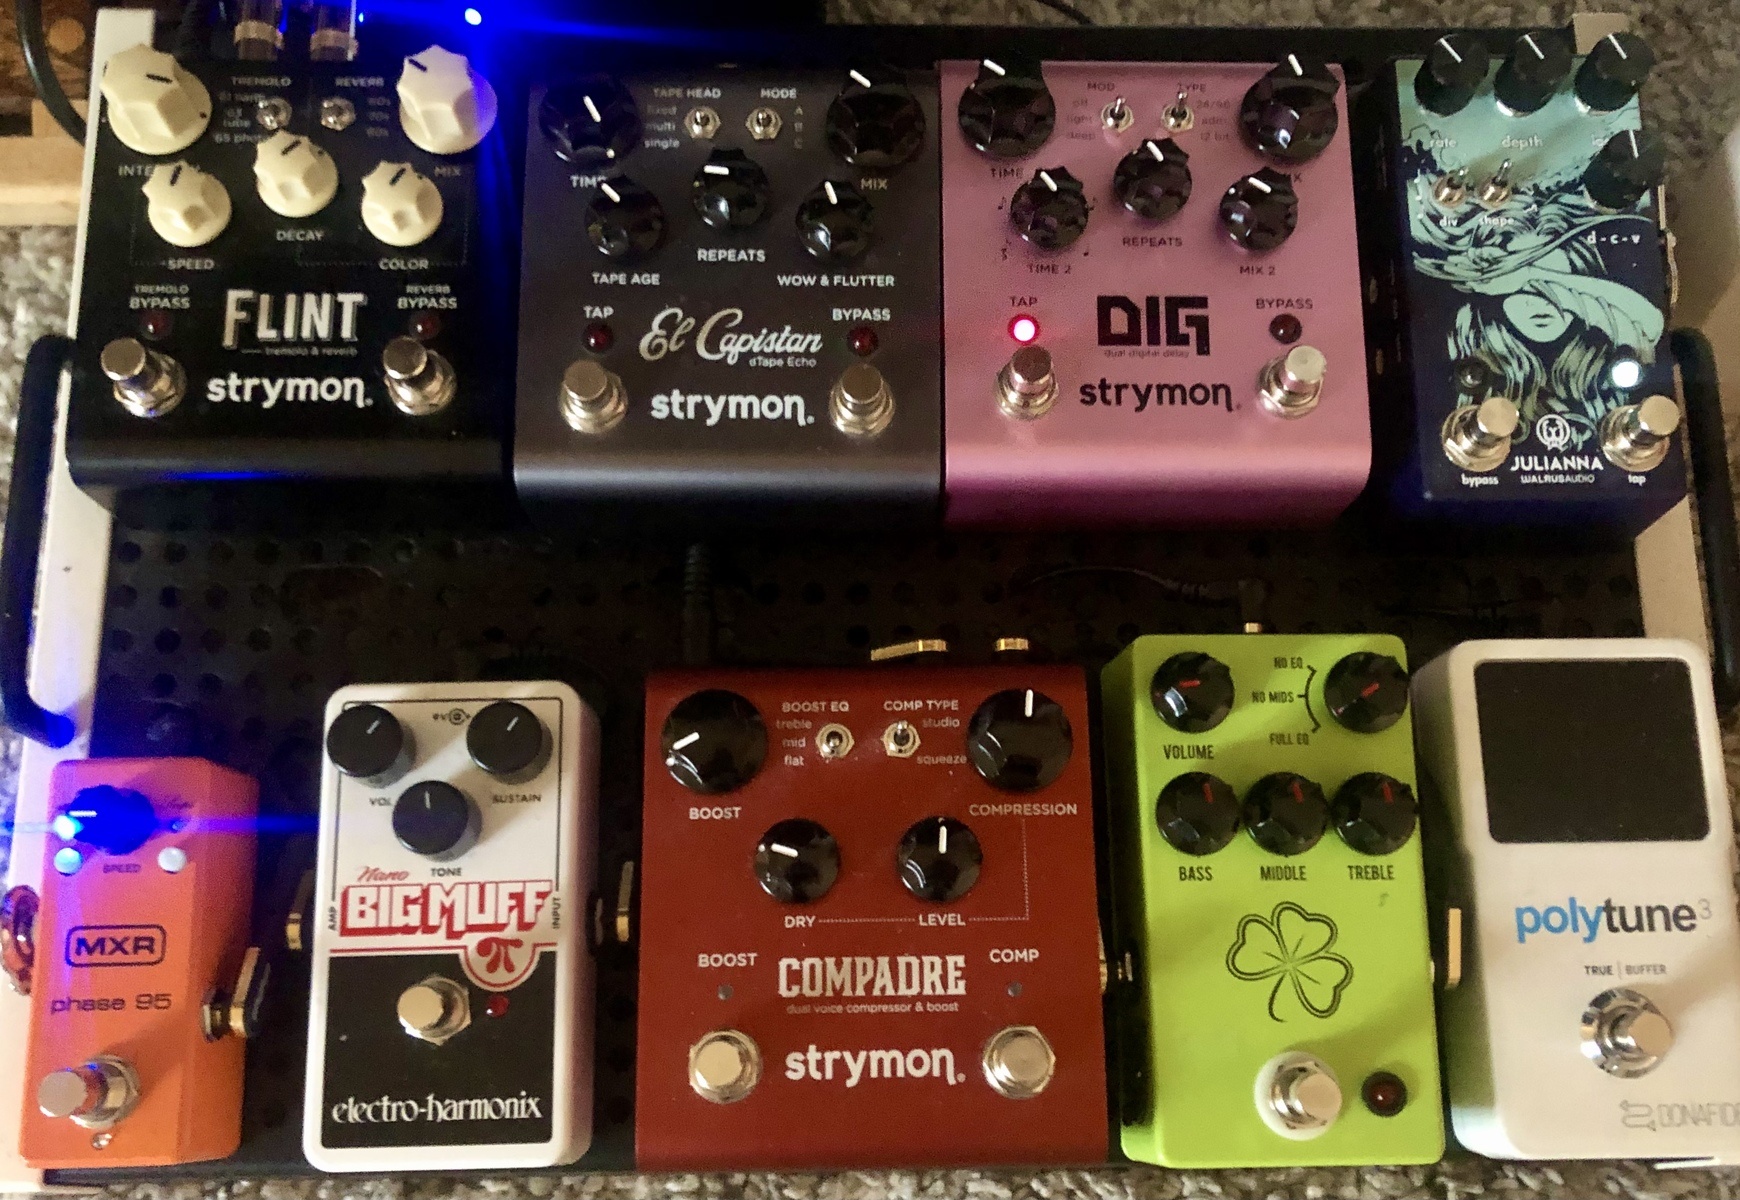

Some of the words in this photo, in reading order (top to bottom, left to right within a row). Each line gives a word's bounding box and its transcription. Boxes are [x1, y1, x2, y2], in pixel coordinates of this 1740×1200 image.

[335, 76, 385, 87] REVERB
[1087, 82, 1115, 92] MOD
[1177, 82, 1207, 93] TYPE
[653, 88, 683, 98] TAPE
[687, 88, 722, 99] HEAD
[760, 88, 797, 99] MODE
[646, 122, 676, 131] multi
[644, 139, 680, 149] single
[1430, 137, 1456, 148] rate
[1501, 134, 1542, 150] depth
[434, 165, 462, 177] MIX
[990, 167, 1024, 178] TIME
[860, 178, 888, 190] MIX
[1439, 215, 1458, 227] div
[276, 230, 324, 242] DECAY
[1122, 236, 1183, 248] REPEATS
[697, 248, 766, 263] REPEATS
[167, 258, 215, 271] SPEED
[379, 258, 430, 271] COLOR
[1027, 263, 1060, 275] TIME
[1064, 264, 1072, 275] 2
[1239, 265, 1263, 276] MIX
[1267, 265, 1276, 276] 2
[592, 273, 628, 286] TAPE
[631, 273, 661, 286] AGE
[777, 274, 816, 288] WOW
[820, 275, 831, 287] &
[833, 275, 895, 288] FLUTTER
[134, 284, 189, 294] TREMOLO
[405, 284, 451, 294] REVERB
[129, 296, 190, 310] BYPASS
[397, 297, 458, 311] BYPASS
[1009, 296, 1038, 308] TAP
[1255, 297, 1314, 310] BYPASS
[583, 305, 614, 318] TAP
[832, 308, 891, 322] BYPASS
[222, 288, 367, 350] FLINT
[1096, 295, 1211, 356] DIG
[638, 307, 695, 362] El
[695, 308, 823, 366] Capistan
[786, 356, 817, 367] Echo
[1510, 455, 1604, 471] JULIANNA
[1462, 473, 1499, 487] bypass
[1628, 474, 1646, 486] tap
[1274, 657, 1287, 669] NO
[1290, 657, 1303, 669] EQ
[1252, 691, 1266, 703] NO
[1269, 691, 1294, 703] MIDS
[782, 702, 826, 712] BOOST
[831, 702, 849, 712] EQ
[884, 700, 923, 711] COMP
[927, 700, 959, 711] TYPE
[922, 717, 960, 728] studio
[783, 737, 806, 747] mid
[1269, 733, 1294, 745] FULL
[1296, 734, 1309, 745] EQ
[1164, 745, 1214, 759] VOLUME
[784, 755, 804, 766] flat
[917, 754, 968, 765] squeeze
[369, 797, 391, 806] VOL
[492, 794, 541, 803] SUSTAIN
[689, 806, 741, 820] BOOST
[969, 803, 1078, 817] COMPRESSION
[357, 866, 410, 882] Nano
[431, 867, 462, 877] TONE
[1179, 866, 1213, 881] BASS
[1260, 866, 1307, 881] MIDDLE
[1347, 866, 1395, 880] TREBLE
[327, 907, 337, 931] AMP
[553, 897, 561, 930] INPUT
[784, 915, 816, 929] DRY
[918, 914, 966, 927] LEVEL
[74, 936, 156, 957] MXR
[698, 953, 757, 967] BOOST
[990, 949, 1039, 963] COMP
[1585, 965, 1613, 976] TRUE
[1626, 964, 1667, 976] BUFFER
[778, 954, 967, 999] COMPADRE
[51, 996, 126, 1015] phase
[135, 993, 172, 1010] 95
[814, 1004, 843, 1013] voice
[846, 1003, 911, 1016] compressor
[915, 1002, 924, 1012] &
[927, 1001, 958, 1012] boost
[332, 1090, 543, 1123] electro-harmonix
